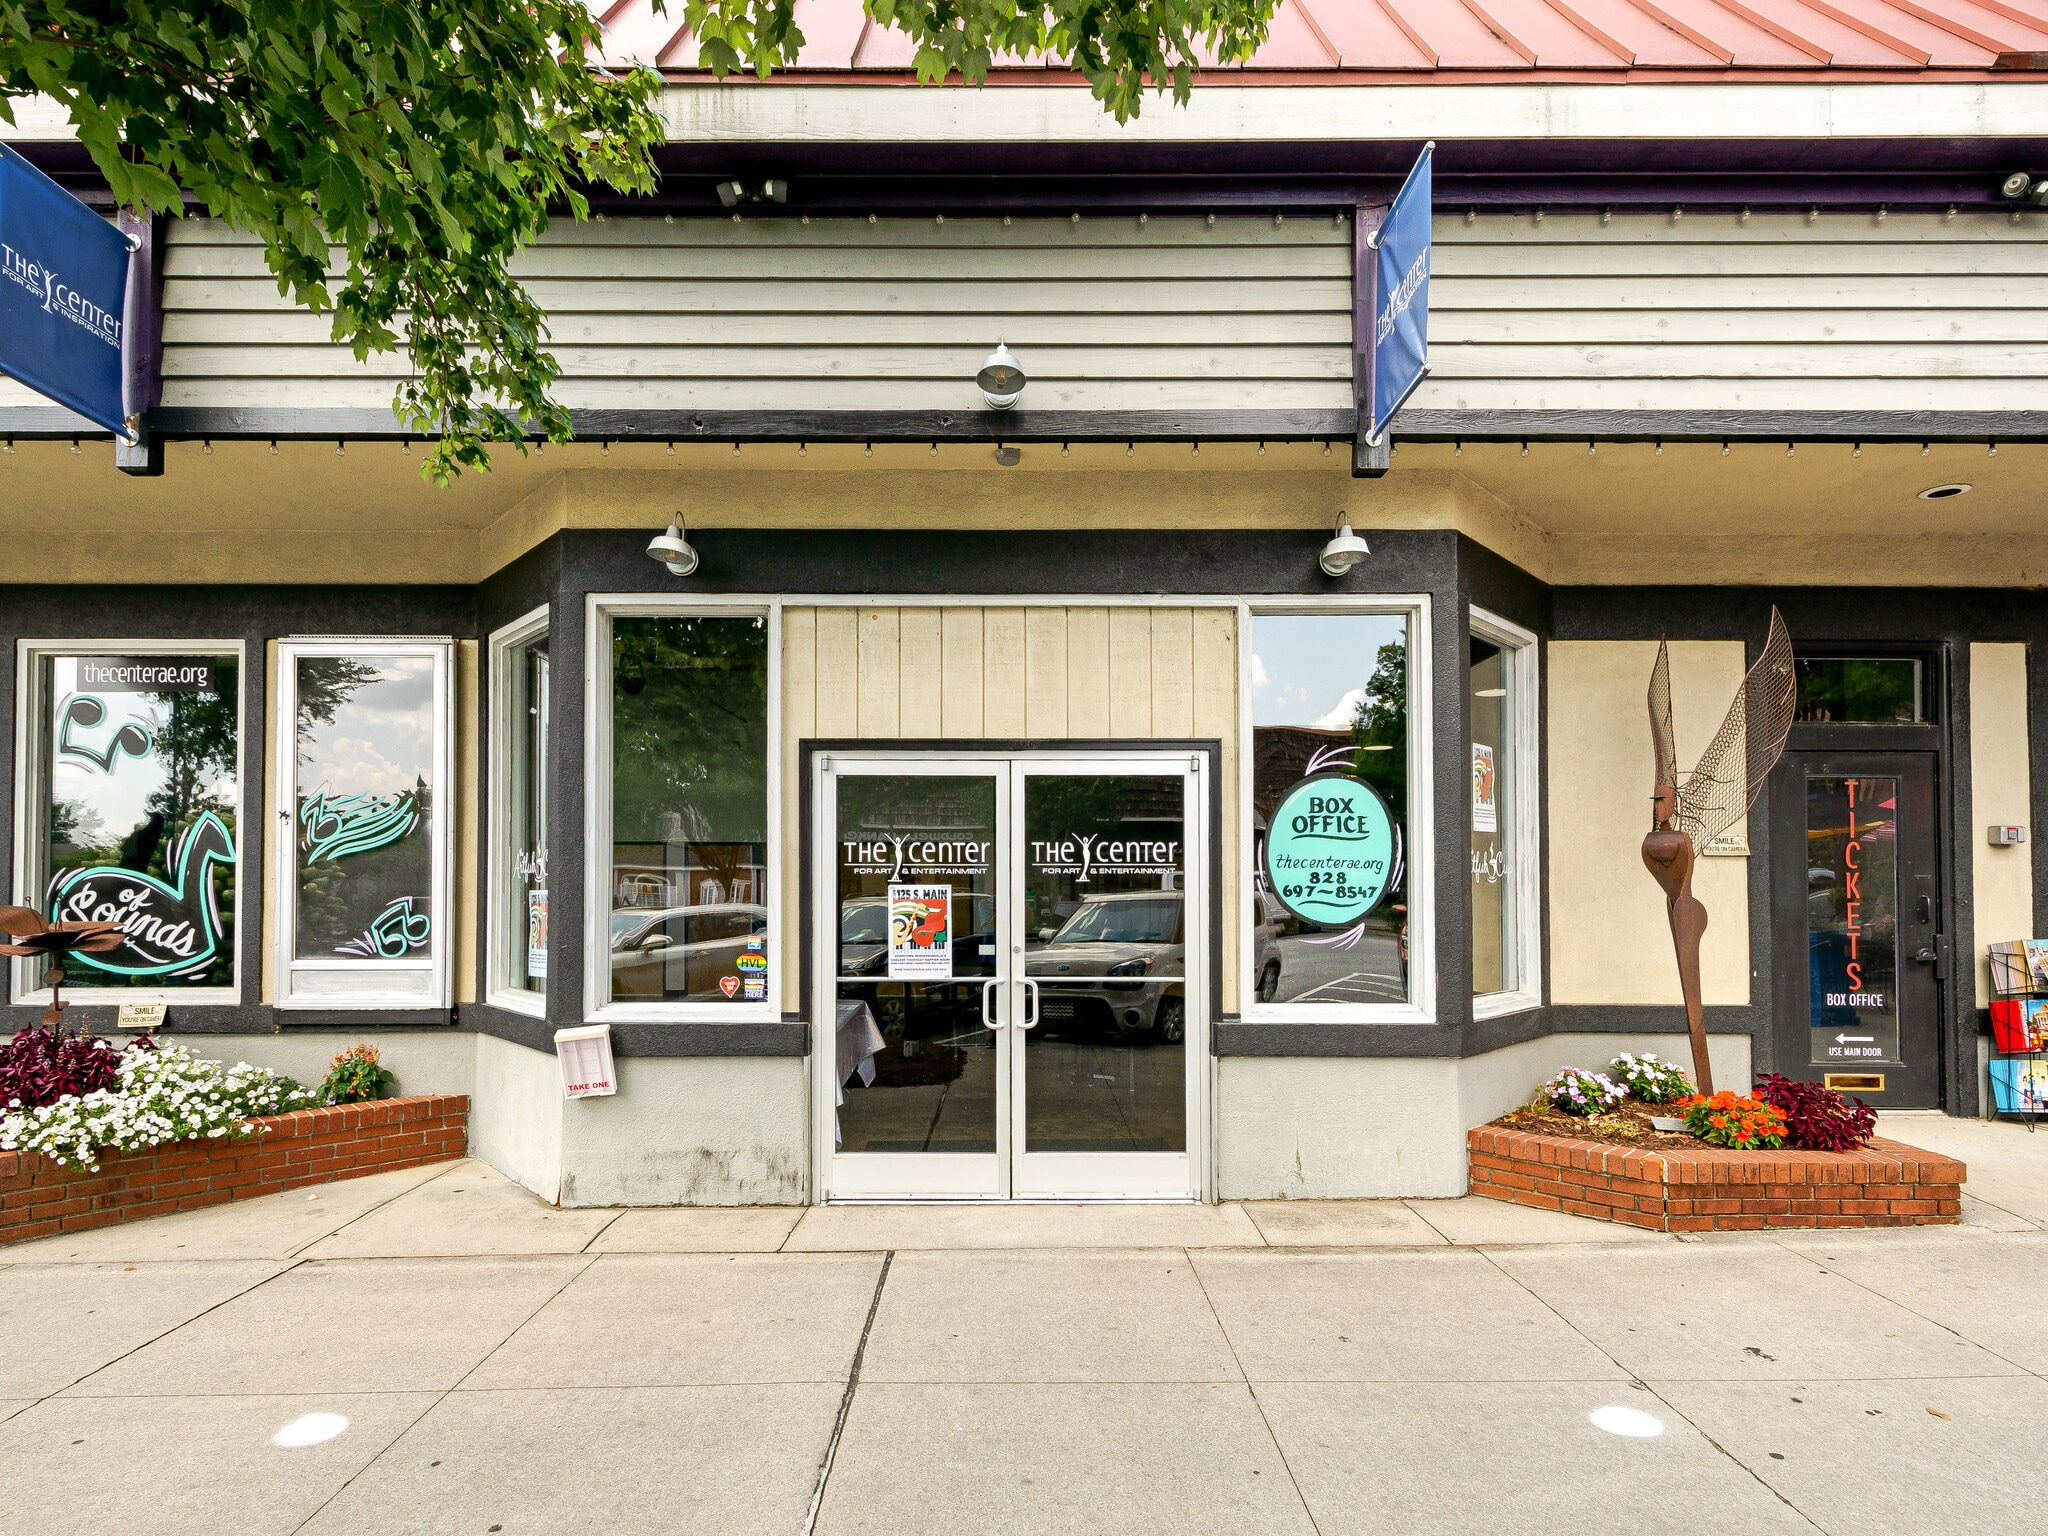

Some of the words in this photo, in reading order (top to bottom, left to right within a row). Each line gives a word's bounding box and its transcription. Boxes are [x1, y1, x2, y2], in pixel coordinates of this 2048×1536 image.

[2, 268, 24, 286] FOR
[25, 284, 45, 299] ART
[61, 308, 120, 350] INSPIRATION
[84, 663, 208, 686] thecenterae.org
[1309, 797, 1355, 814] BOX
[1292, 815, 1370, 834] OFFICE
[1714, 837, 1735, 845] SMILE
[1276, 854, 1384, 875] thecenterae.org
[1309, 872, 1347, 884] 828
[1844, 781, 1862, 991] TICKETS
[119, 888, 153, 911] of
[897, 889, 911, 900] 125
[913, 889, 921, 900] S.
[923, 889, 948, 900] MAIN
[61, 883, 197, 956] Sounds
[741, 958, 762, 968] HVL
[1827, 994, 1847, 1006] BOX
[1849, 994, 1884, 1007] OFFICE
[134, 1007, 156, 1015] SMILE
[1828, 1047, 1842, 1056] USE
[1844, 1047, 1861, 1056] MAIN
[1862, 1047, 1882, 1057] DOOR
[568, 1083, 590, 1091] TAKE
[592, 1081, 610, 1089] ONE
